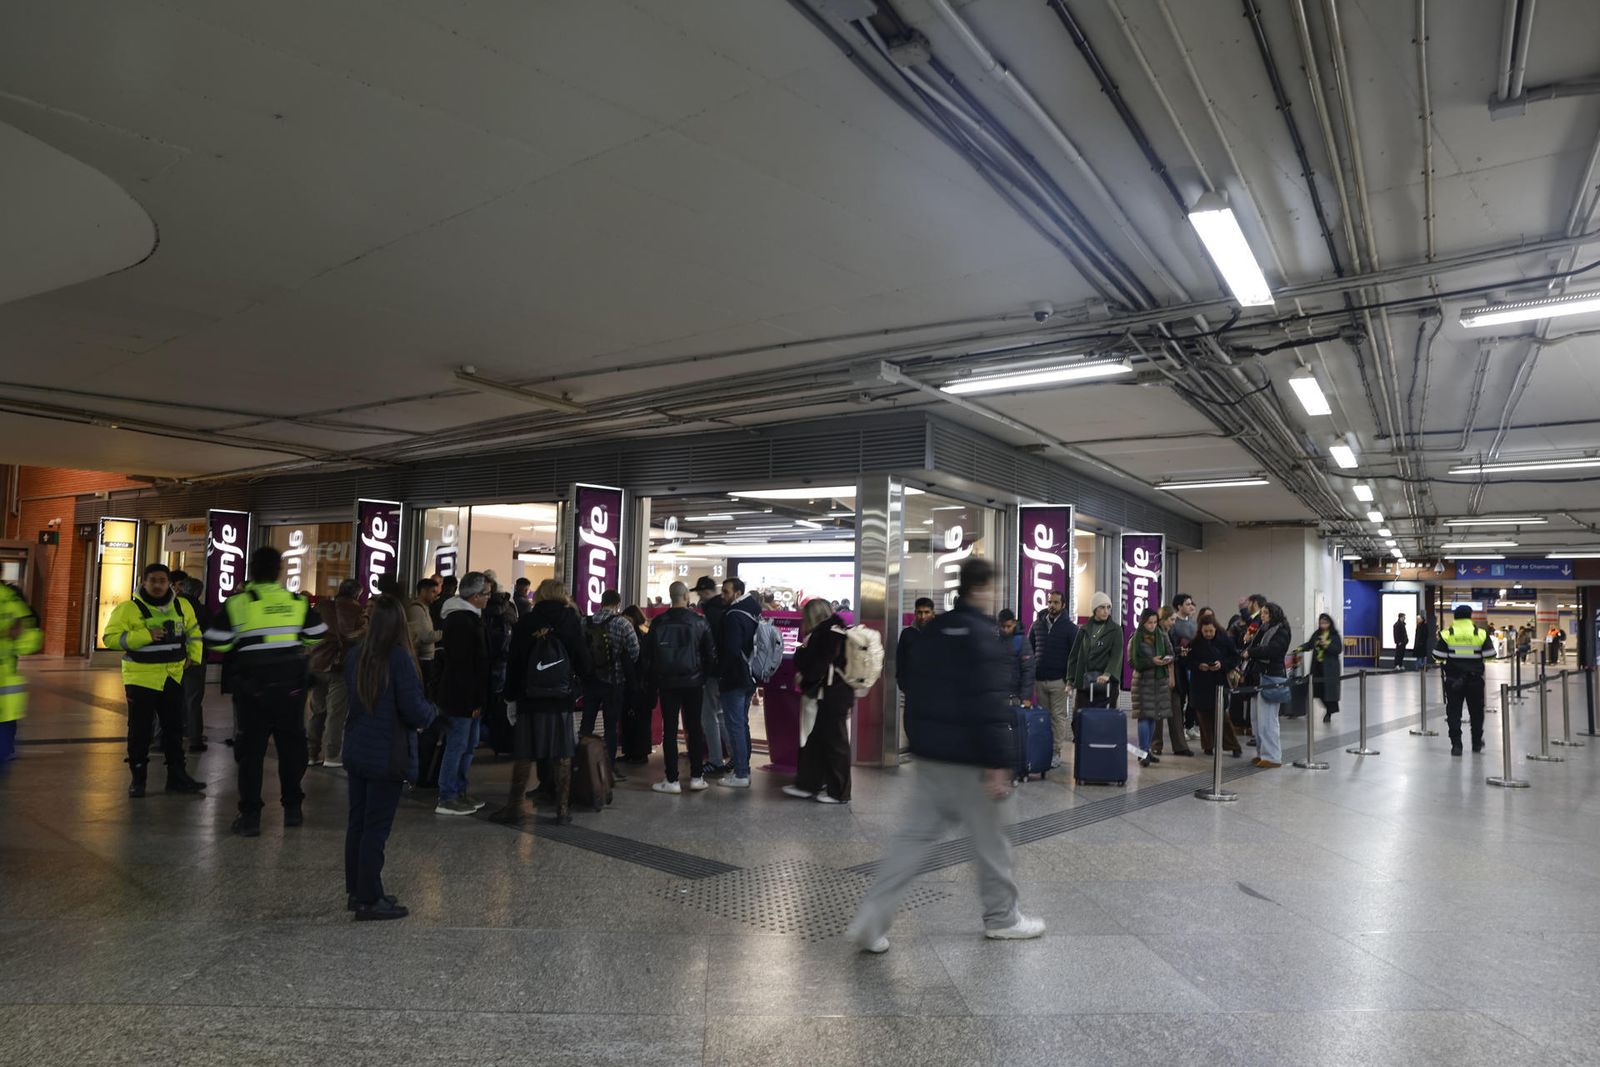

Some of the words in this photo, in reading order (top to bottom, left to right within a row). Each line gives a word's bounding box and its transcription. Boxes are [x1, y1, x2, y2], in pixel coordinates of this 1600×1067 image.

[361, 516, 395, 598] enfe
[679, 564, 688, 577] 12
[713, 564, 723, 577] 13
[1022, 524, 1065, 622] enfe
